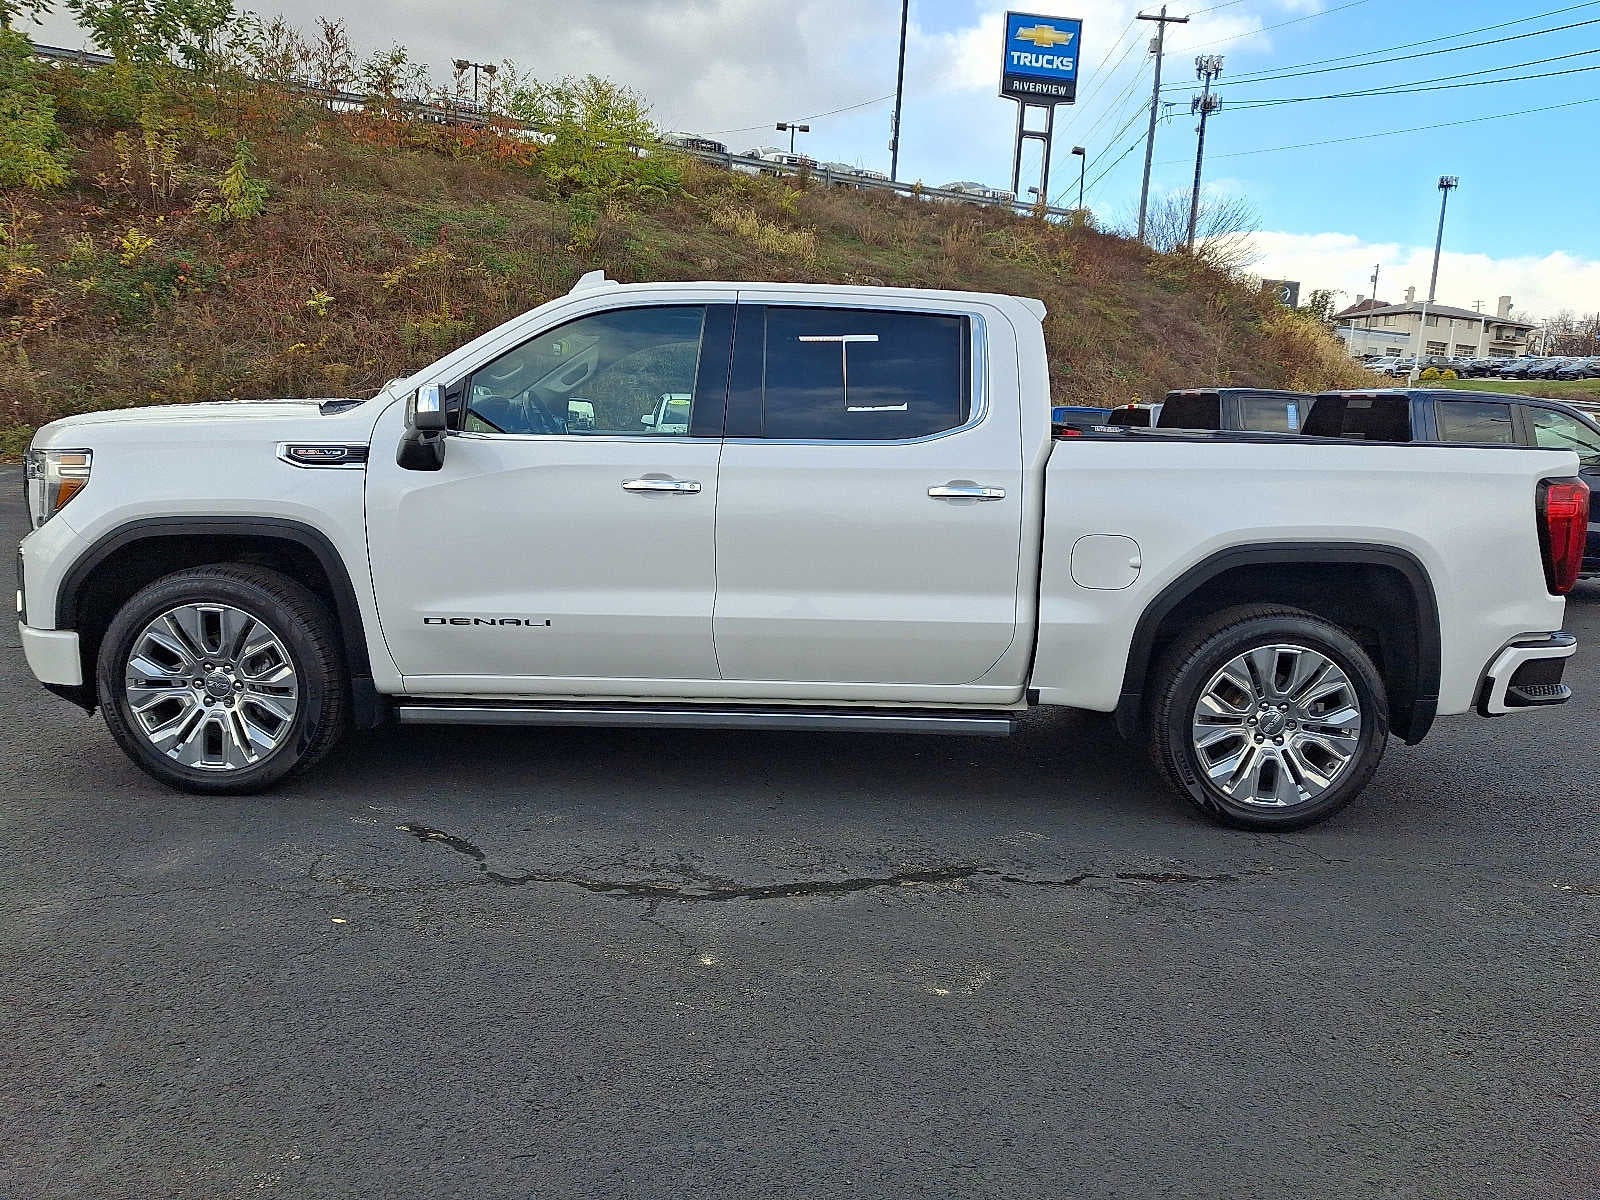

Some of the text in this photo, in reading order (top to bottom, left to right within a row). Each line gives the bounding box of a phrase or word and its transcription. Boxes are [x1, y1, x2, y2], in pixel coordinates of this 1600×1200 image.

[1011, 51, 1073, 70] TRUCKS
[1013, 80, 1066, 95] RIVERVIEW
[423, 617, 551, 627] DENALI
